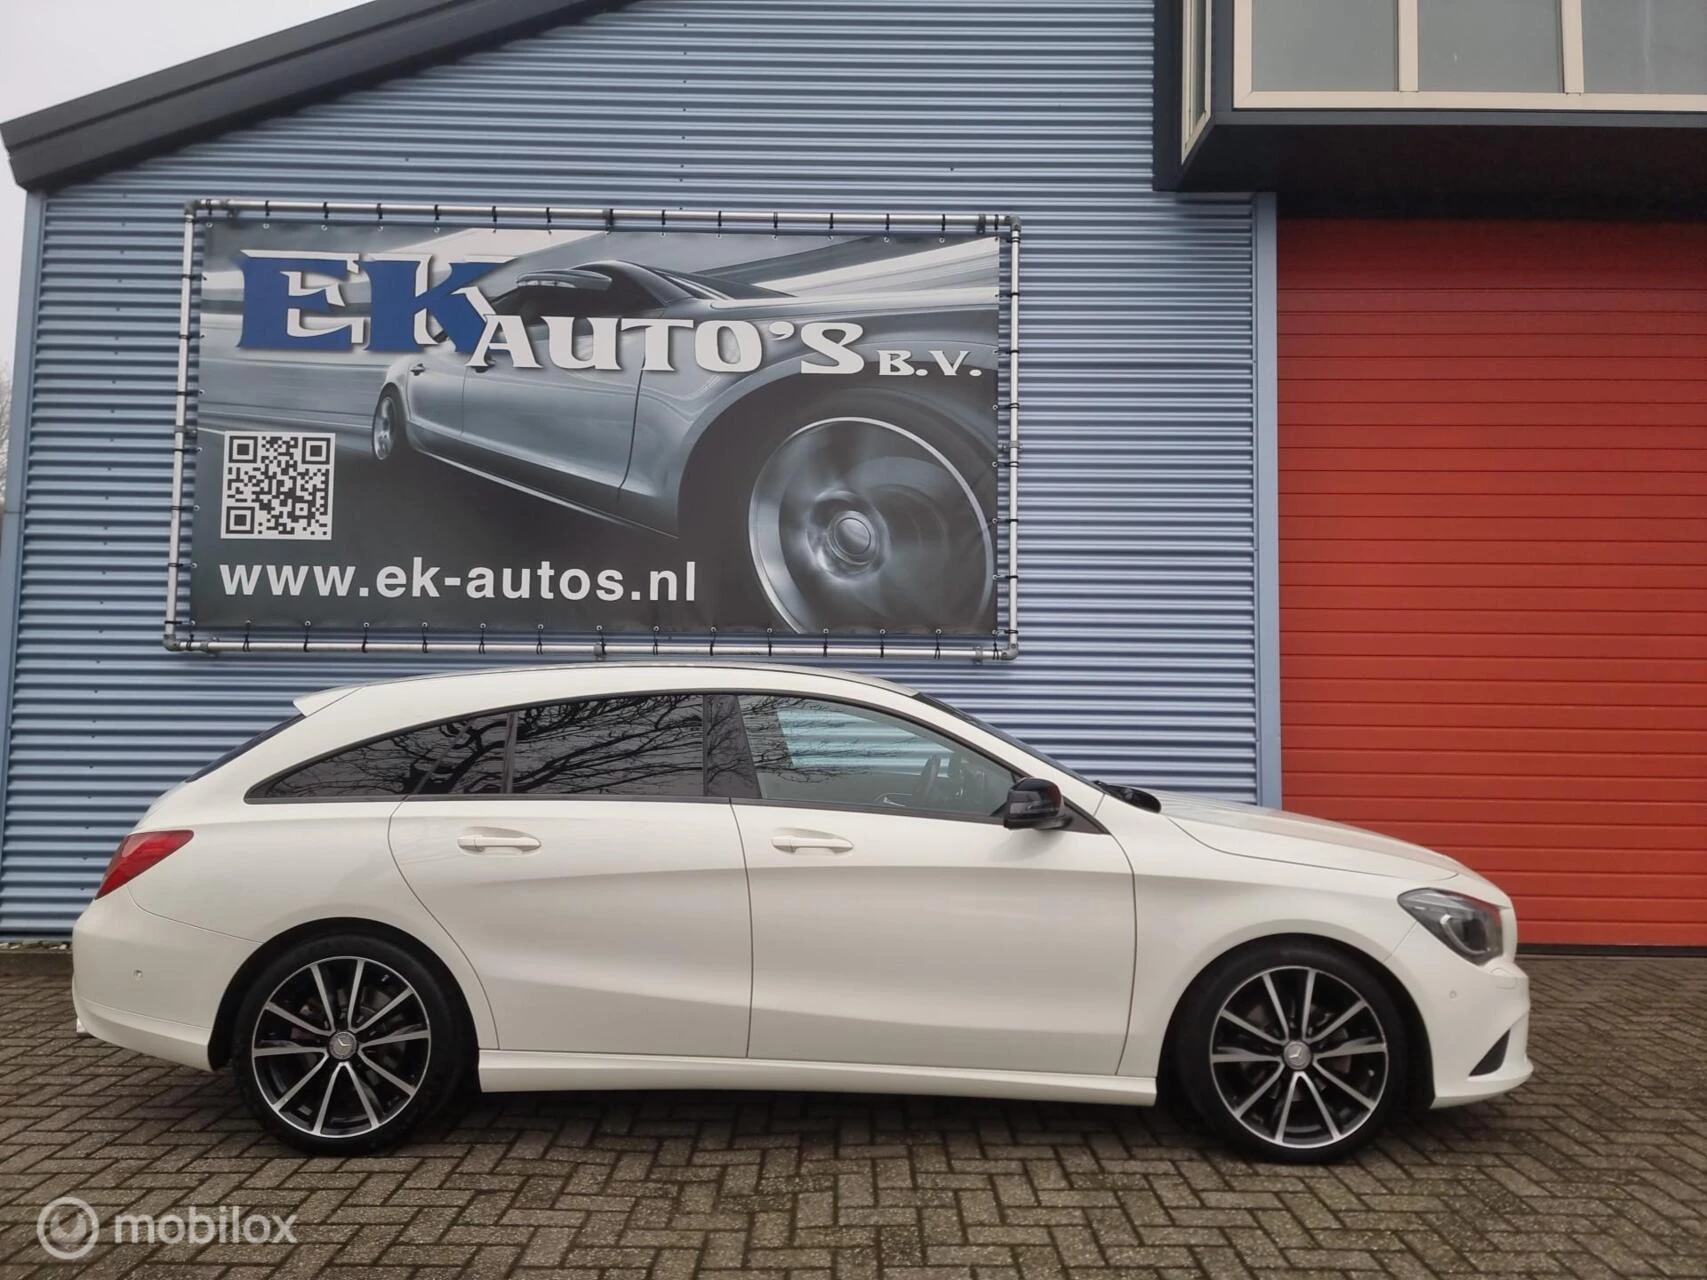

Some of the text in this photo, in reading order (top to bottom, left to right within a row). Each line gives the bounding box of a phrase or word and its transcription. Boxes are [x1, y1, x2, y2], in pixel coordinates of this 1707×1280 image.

[236, 249, 519, 354] EK
[877, 349, 983, 377] B.V.
[219, 556, 696, 602] www.ek-autos.nl
